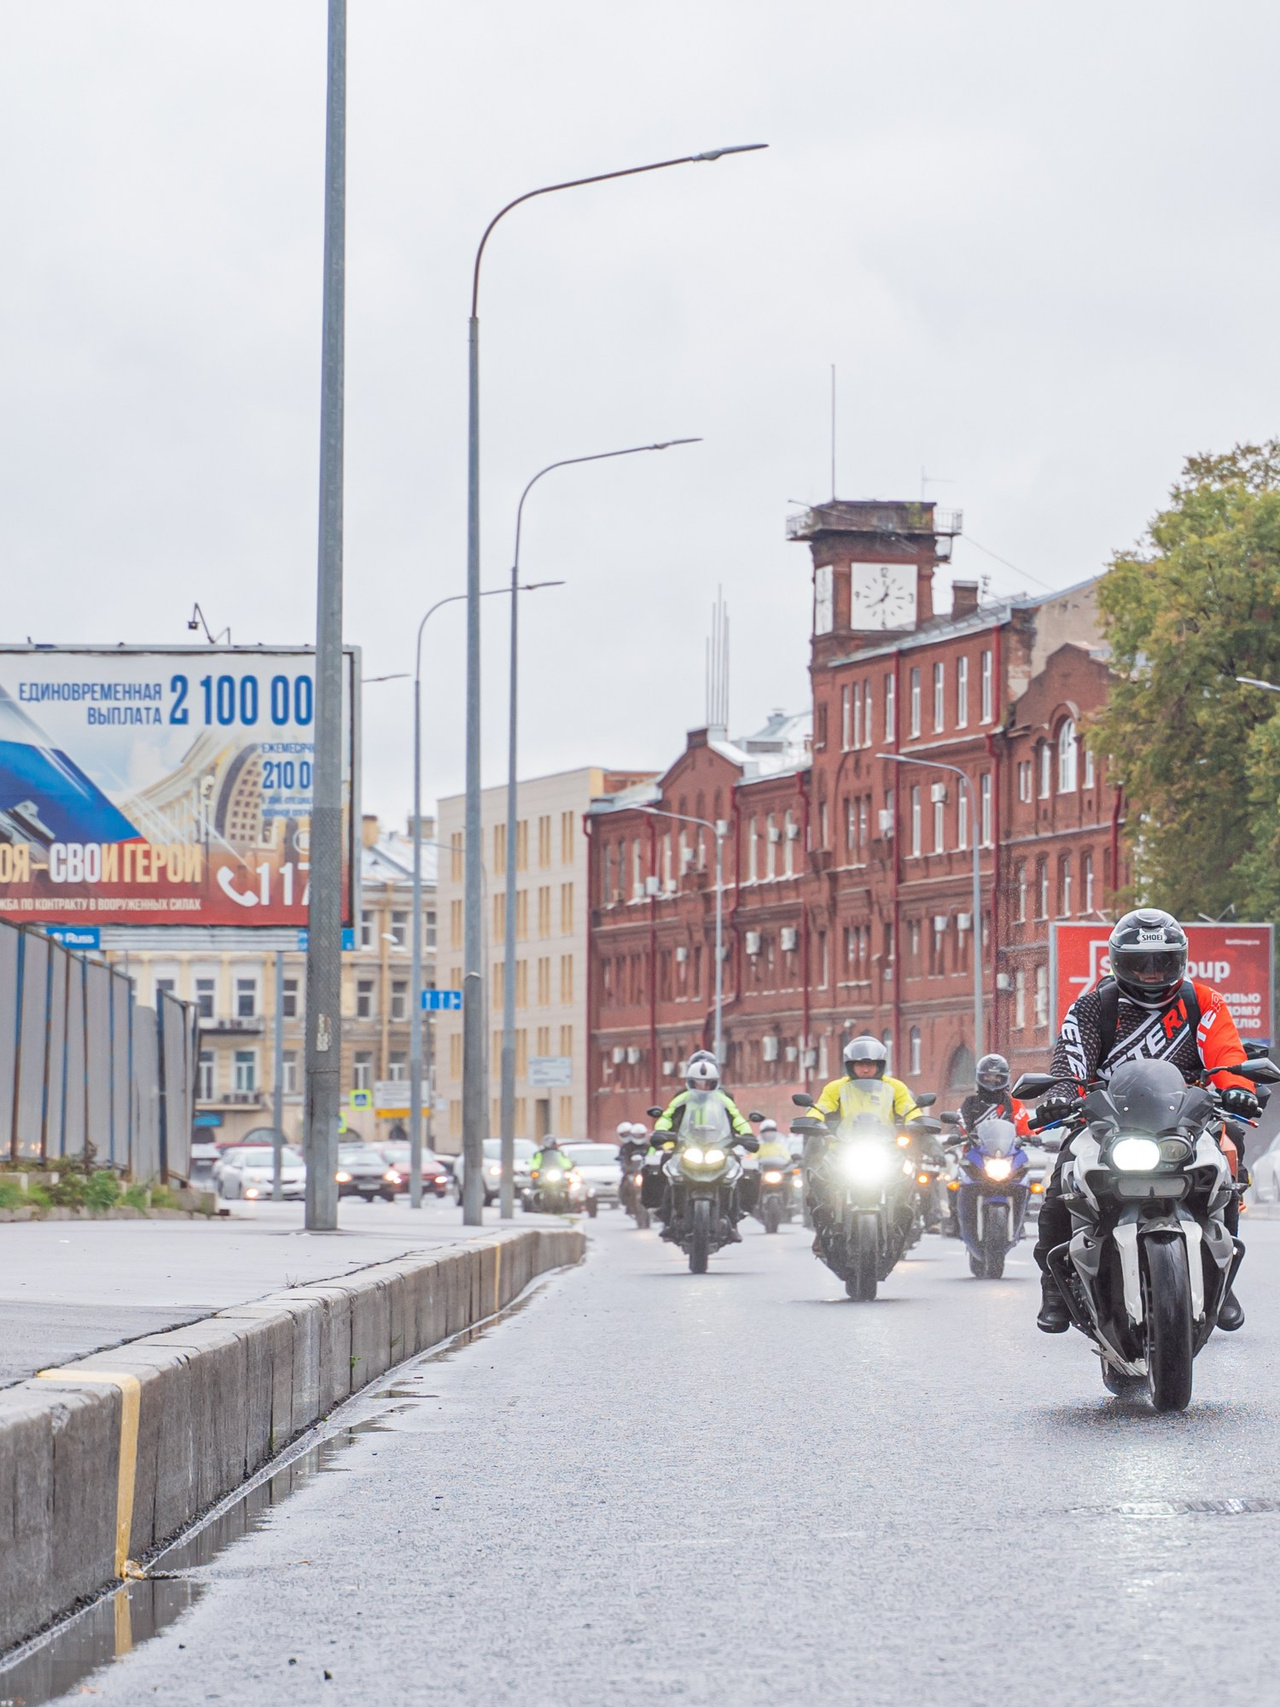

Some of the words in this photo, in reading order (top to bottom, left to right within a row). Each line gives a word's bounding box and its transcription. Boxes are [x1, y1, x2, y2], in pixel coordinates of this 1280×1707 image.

[19, 683, 163, 703] ЕДИНОВРЕМЕННАЯ
[169, 674, 189, 725] 2
[200, 675, 259, 726] 100
[271, 675, 313, 726] 00
[87, 707, 163, 725] ВЫПЛАТА
[262, 761, 295, 789] 210
[50, 843, 119, 883] СВОИ
[123, 843, 202, 883] ГЕРОИ
[21, 898, 33, 911] ПО
[35, 898, 88, 911] КОНТРАКТУ
[98, 898, 168, 911] ВООРУЖЕННЫХ
[169, 898, 202, 911] СИЛАХ
[1185, 961, 1231, 983] oup
[1221, 993, 1262, 1004] ОВЬЮ
